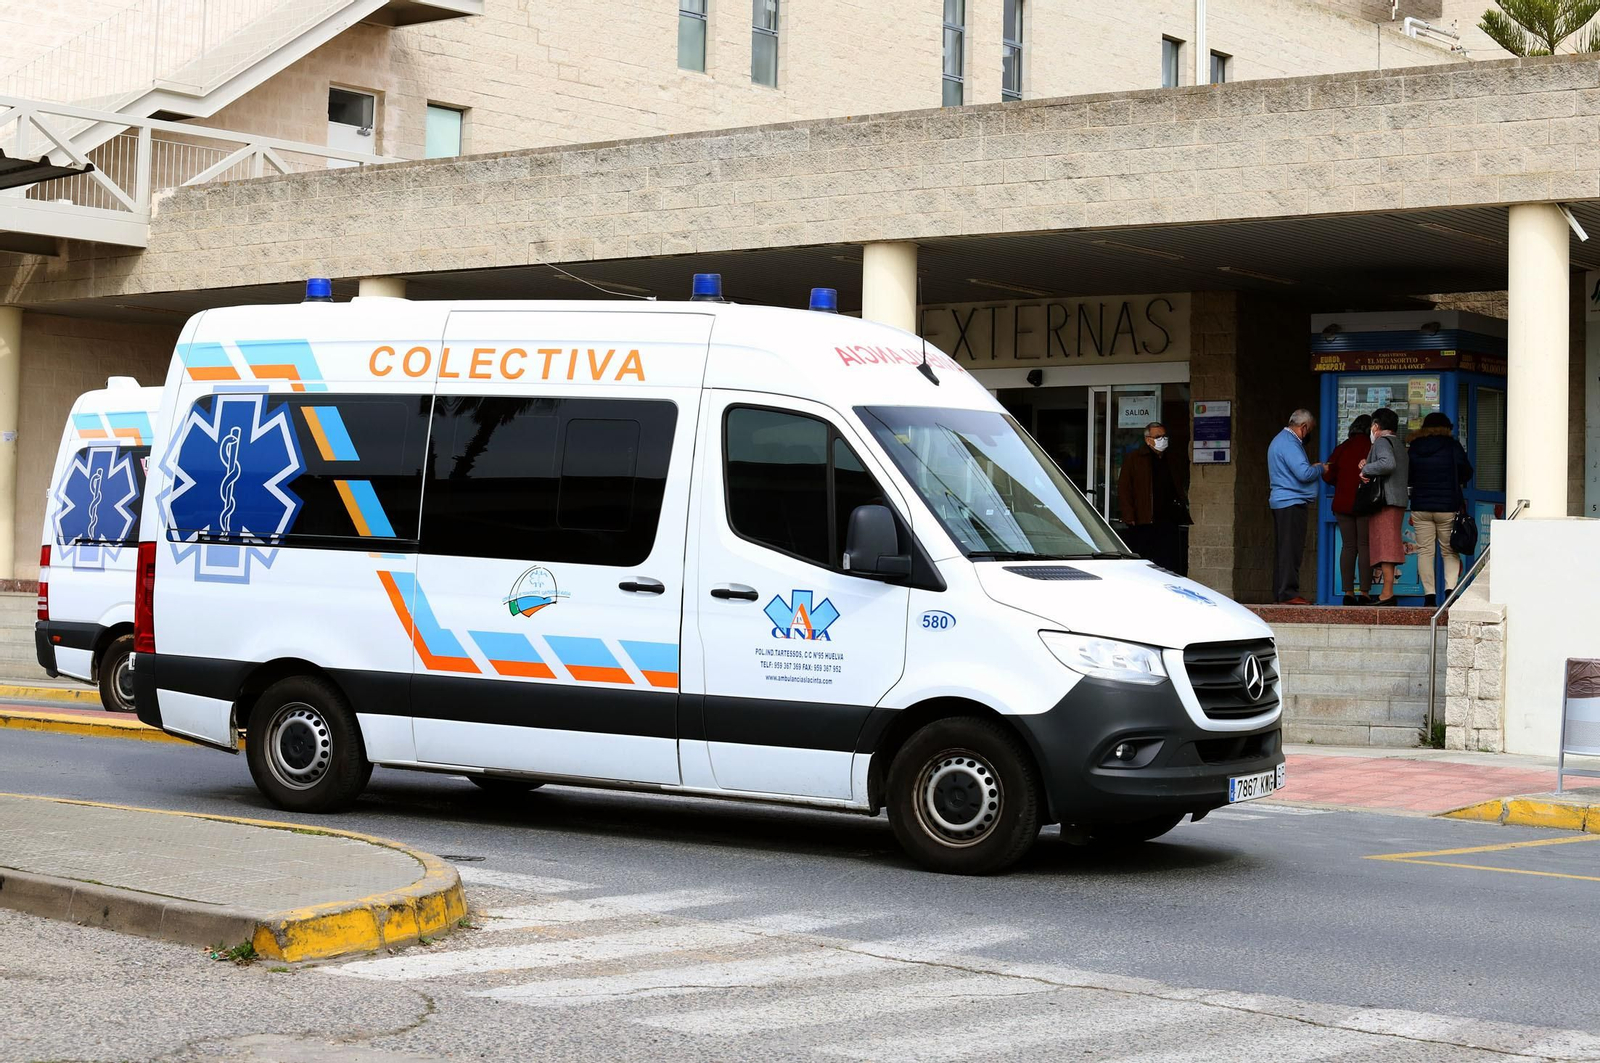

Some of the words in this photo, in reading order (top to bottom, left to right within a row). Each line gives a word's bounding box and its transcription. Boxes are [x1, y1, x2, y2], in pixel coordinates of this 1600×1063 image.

[921, 297, 1174, 361] EXTERNAS
[368, 345, 646, 382] COLECTIVA
[1125, 409, 1149, 417] SALIDA
[922, 615, 948, 629] 580
[771, 627, 831, 641] CINTA
[824, 652, 844, 660] HUELVA
[760, 660, 773, 668] TELF:
[774, 661, 782, 669] 959
[783, 662, 792, 670] 367
[802, 663, 812, 671] FAX:
[813, 664, 822, 672] 959
[832, 665, 841, 673] 952
[765, 674, 833, 685] www.ambulanciaslacinta.com
[1237, 777, 1258, 799] 7867
